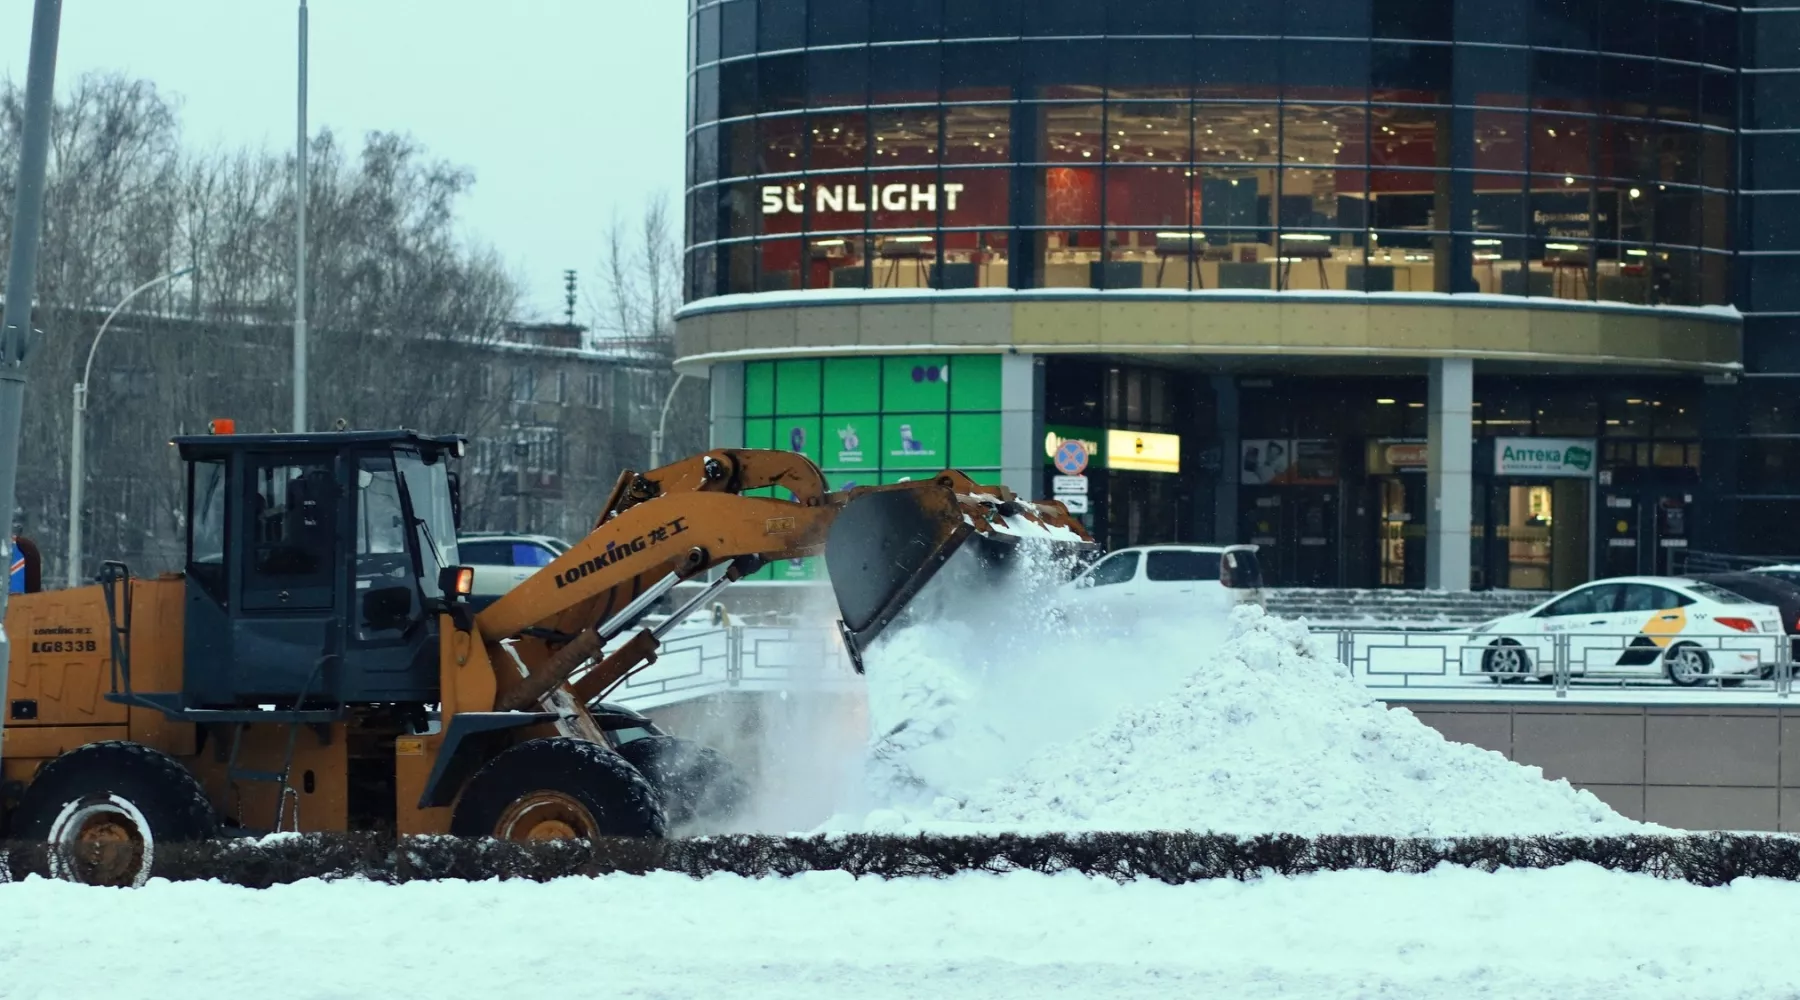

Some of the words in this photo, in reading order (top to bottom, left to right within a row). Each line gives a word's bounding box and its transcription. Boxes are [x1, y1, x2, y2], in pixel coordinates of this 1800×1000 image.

[762, 183, 965, 214] SUNLIGHT
[1502, 445, 1561, 462] Аптека
[647, 516, 689, 545] 龙工
[31, 640, 97, 654] LG833B
